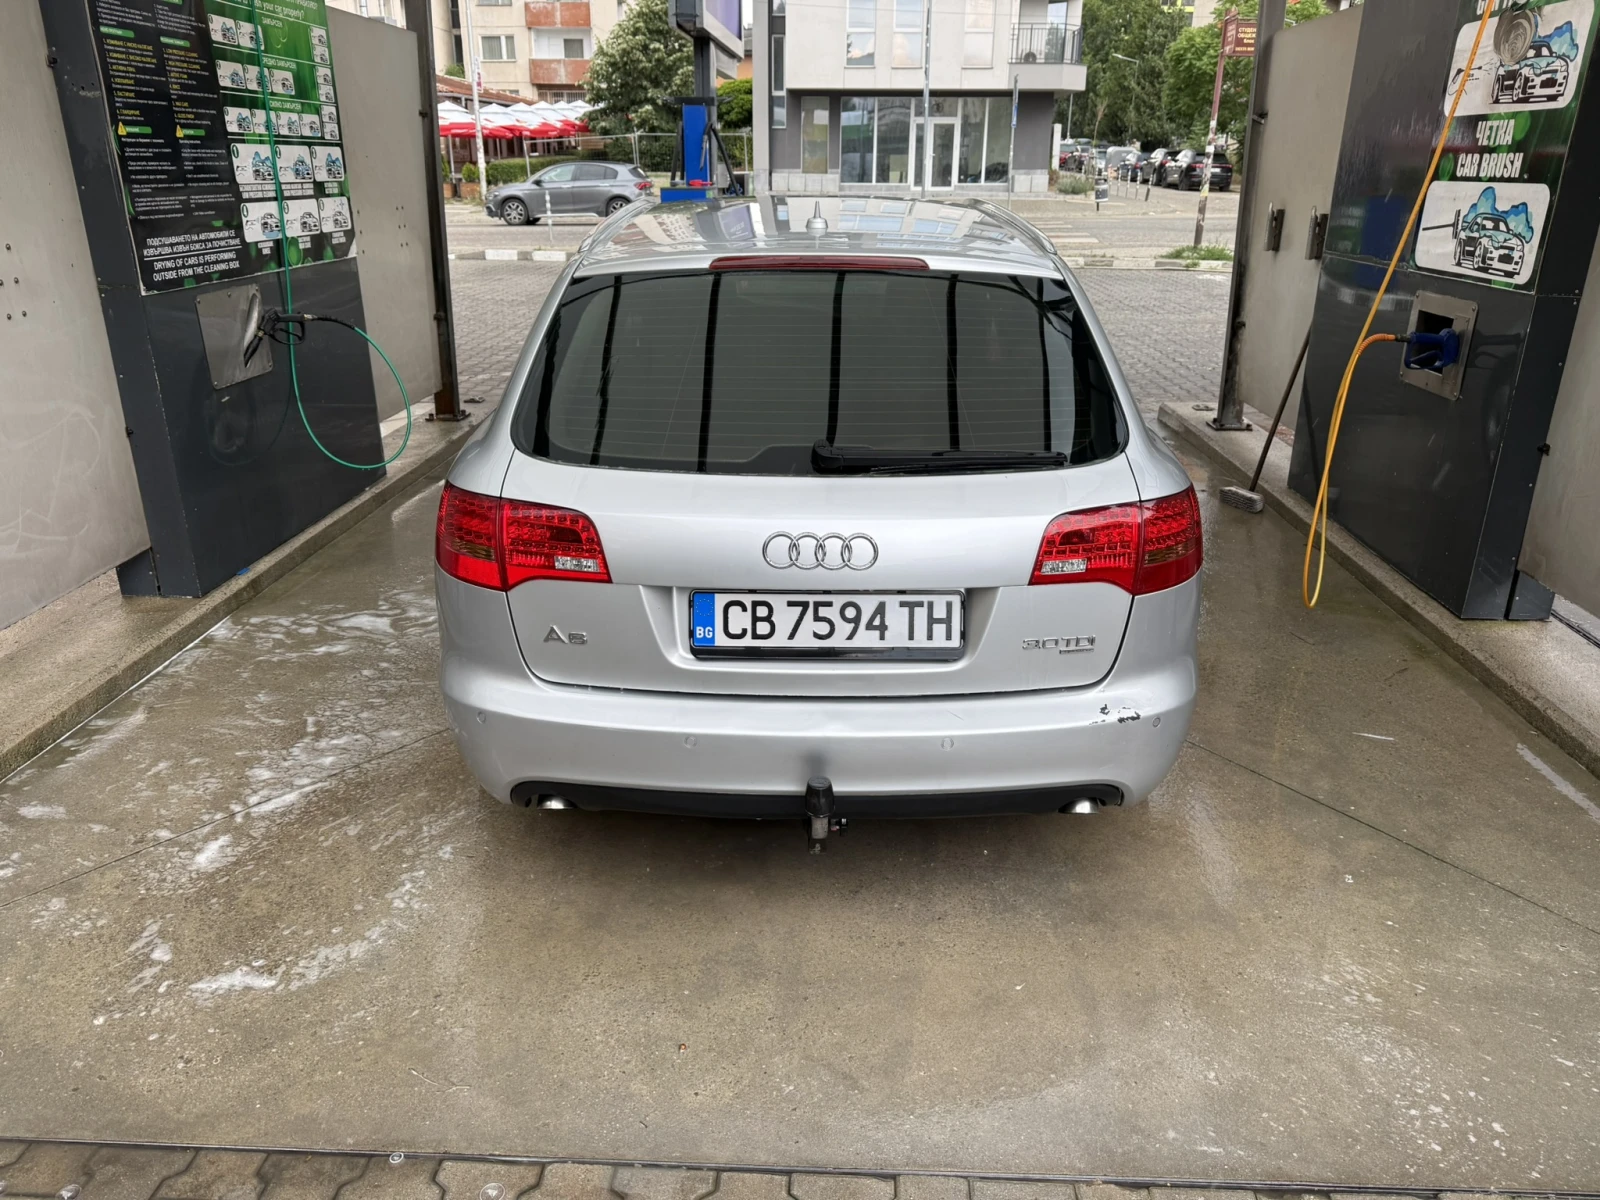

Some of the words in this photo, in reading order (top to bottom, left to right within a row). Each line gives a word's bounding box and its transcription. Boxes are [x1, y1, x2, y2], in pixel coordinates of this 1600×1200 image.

[1476, 119, 1515, 146] ЧЕТКА
[1456, 153, 1480, 177] CAR
[1479, 152, 1524, 178] BRUSH
[143, 246, 172, 256] ИЗВЪРШВА
[173, 244, 190, 253] ИЗВЪН
[190, 243, 206, 251] БОКСА
[212, 238, 241, 247] ПОЧИСТВАНЕ
[146, 234, 191, 246] ПОДСУШАВАНЕТО
[199, 231, 228, 240] АВТОМОБИЛИ
[154, 260, 175, 270] DRYING
[176, 258, 183, 267] OF
[184, 256, 198, 265] CARS
[204, 251, 236, 262] PERFORMING
[153, 270, 178, 281] OUTSIDE
[178, 268, 193, 277] FROM
[194, 267, 204, 275] THE
[204, 262, 229, 273] CLEANING
[229, 260, 240, 269] BOX
[696, 626, 713, 638] BG
[722, 600, 776, 640] CB
[786, 600, 888, 640] 7594
[899, 600, 952, 640] TH
[543, 625, 587, 644] A6
[1061, 634, 1096, 648] TDI
